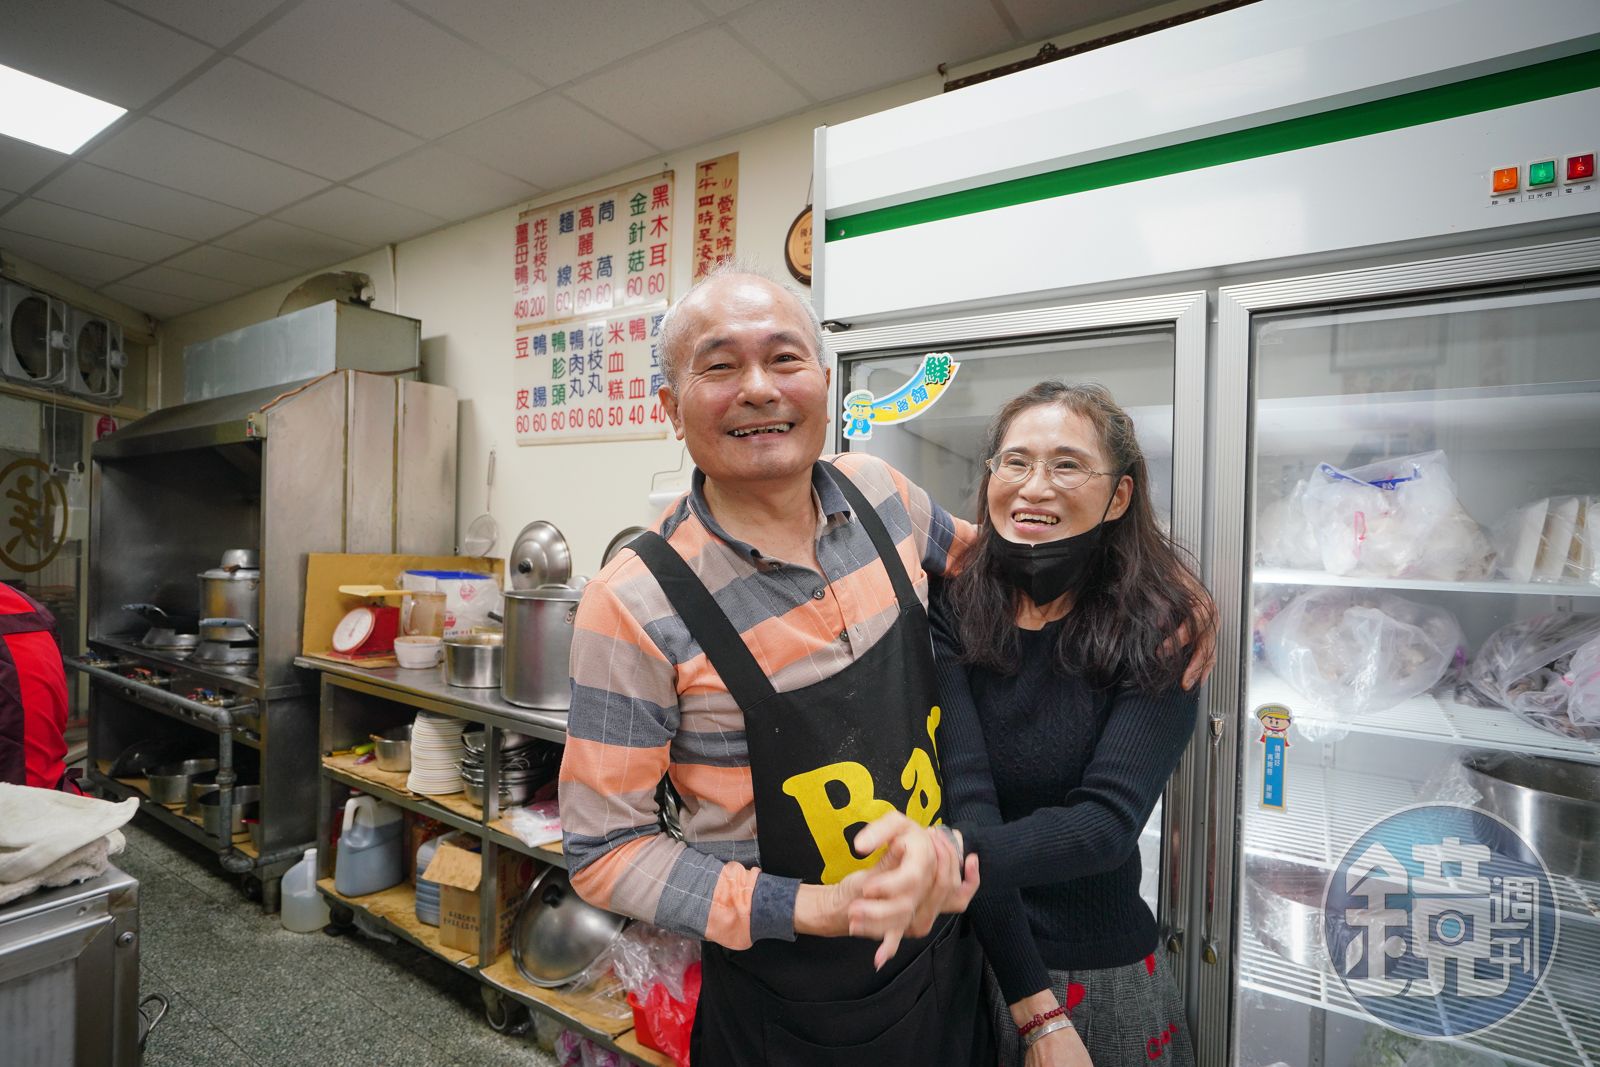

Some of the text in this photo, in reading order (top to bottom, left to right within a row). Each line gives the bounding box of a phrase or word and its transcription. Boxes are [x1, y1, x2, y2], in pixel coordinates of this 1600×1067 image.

[514, 223, 529, 286] 薑母鴨
[530, 218, 548, 318] 炸花枝丸 200
[555, 210, 575, 312] 麵線 60
[577, 205, 594, 309] 高麗菜 60
[596, 200, 615, 304] 茼蒿 60
[627, 192, 647, 298] 金針菇 60
[649, 183, 670, 267] 黑木耳
[514, 300, 529, 319] 450
[648, 272, 665, 295] 60
[515, 336, 530, 433] 豆皮 60
[532, 334, 548, 432] 鴨腸 60
[551, 411, 565, 430] 60
[569, 329, 584, 428] 鴨肉丸 60
[587, 326, 604, 428] 花枝丸 60
[607, 321, 625, 426] 米血糕 50
[628, 318, 646, 425] 鴨血 40
[650, 403, 667, 424] 40
[782, 705, 943, 886] Ba
